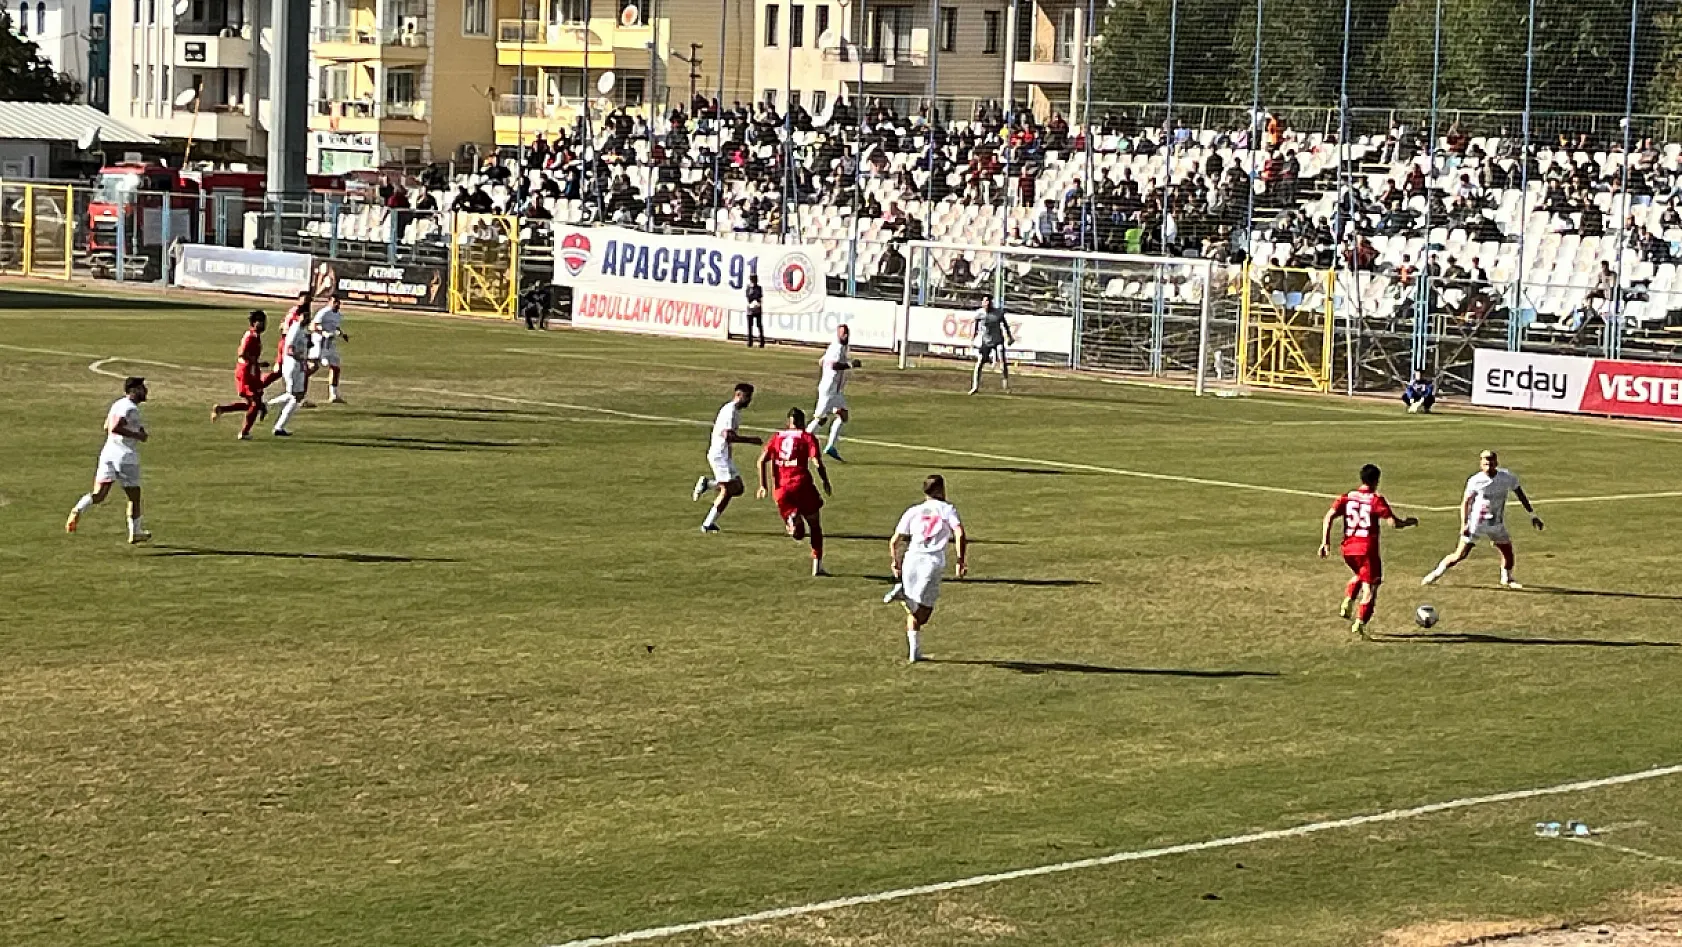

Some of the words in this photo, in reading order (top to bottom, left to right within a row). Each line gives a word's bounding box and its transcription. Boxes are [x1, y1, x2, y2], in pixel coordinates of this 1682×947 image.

[602, 239, 722, 287] APACHES
[728, 254, 759, 290] 91
[579, 293, 650, 321] ABDULLAH
[654, 297, 723, 329] KOYUNCU
[1487, 364, 1567, 399] erday
[780, 436, 794, 460] 9
[921, 515, 942, 541] 7
[1345, 500, 1372, 528] 55
